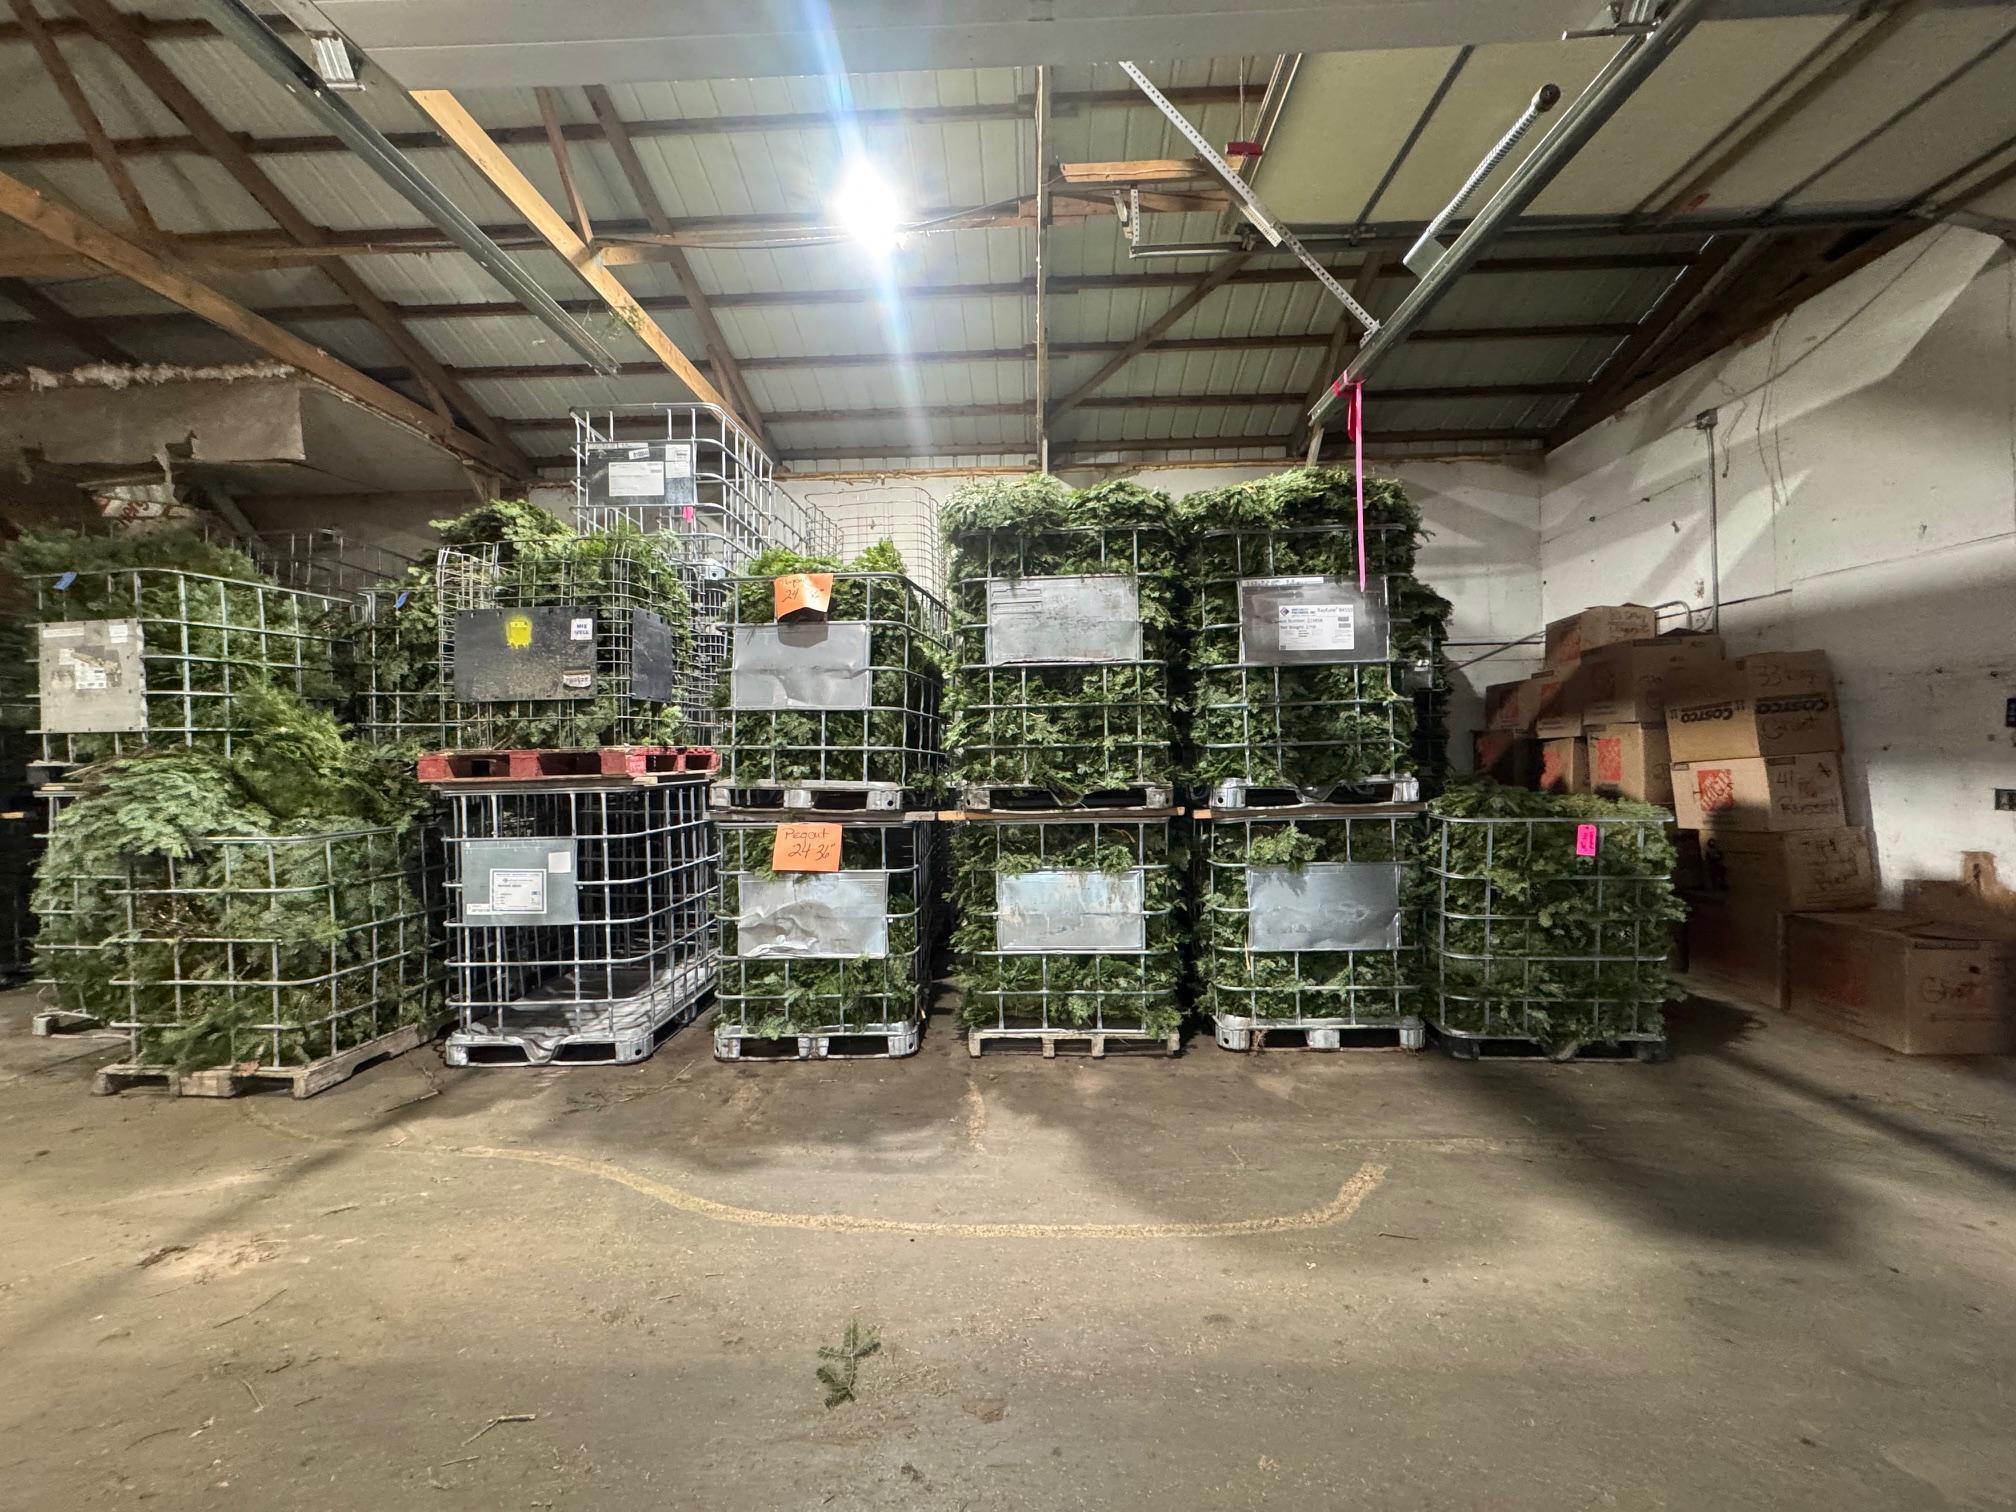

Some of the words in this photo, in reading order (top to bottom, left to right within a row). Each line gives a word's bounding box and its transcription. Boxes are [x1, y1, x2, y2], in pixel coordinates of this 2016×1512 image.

[1755, 698, 1829, 715] COSTCO
[1680, 707, 1734, 723] COSTCO
[788, 843, 811, 859] 24
